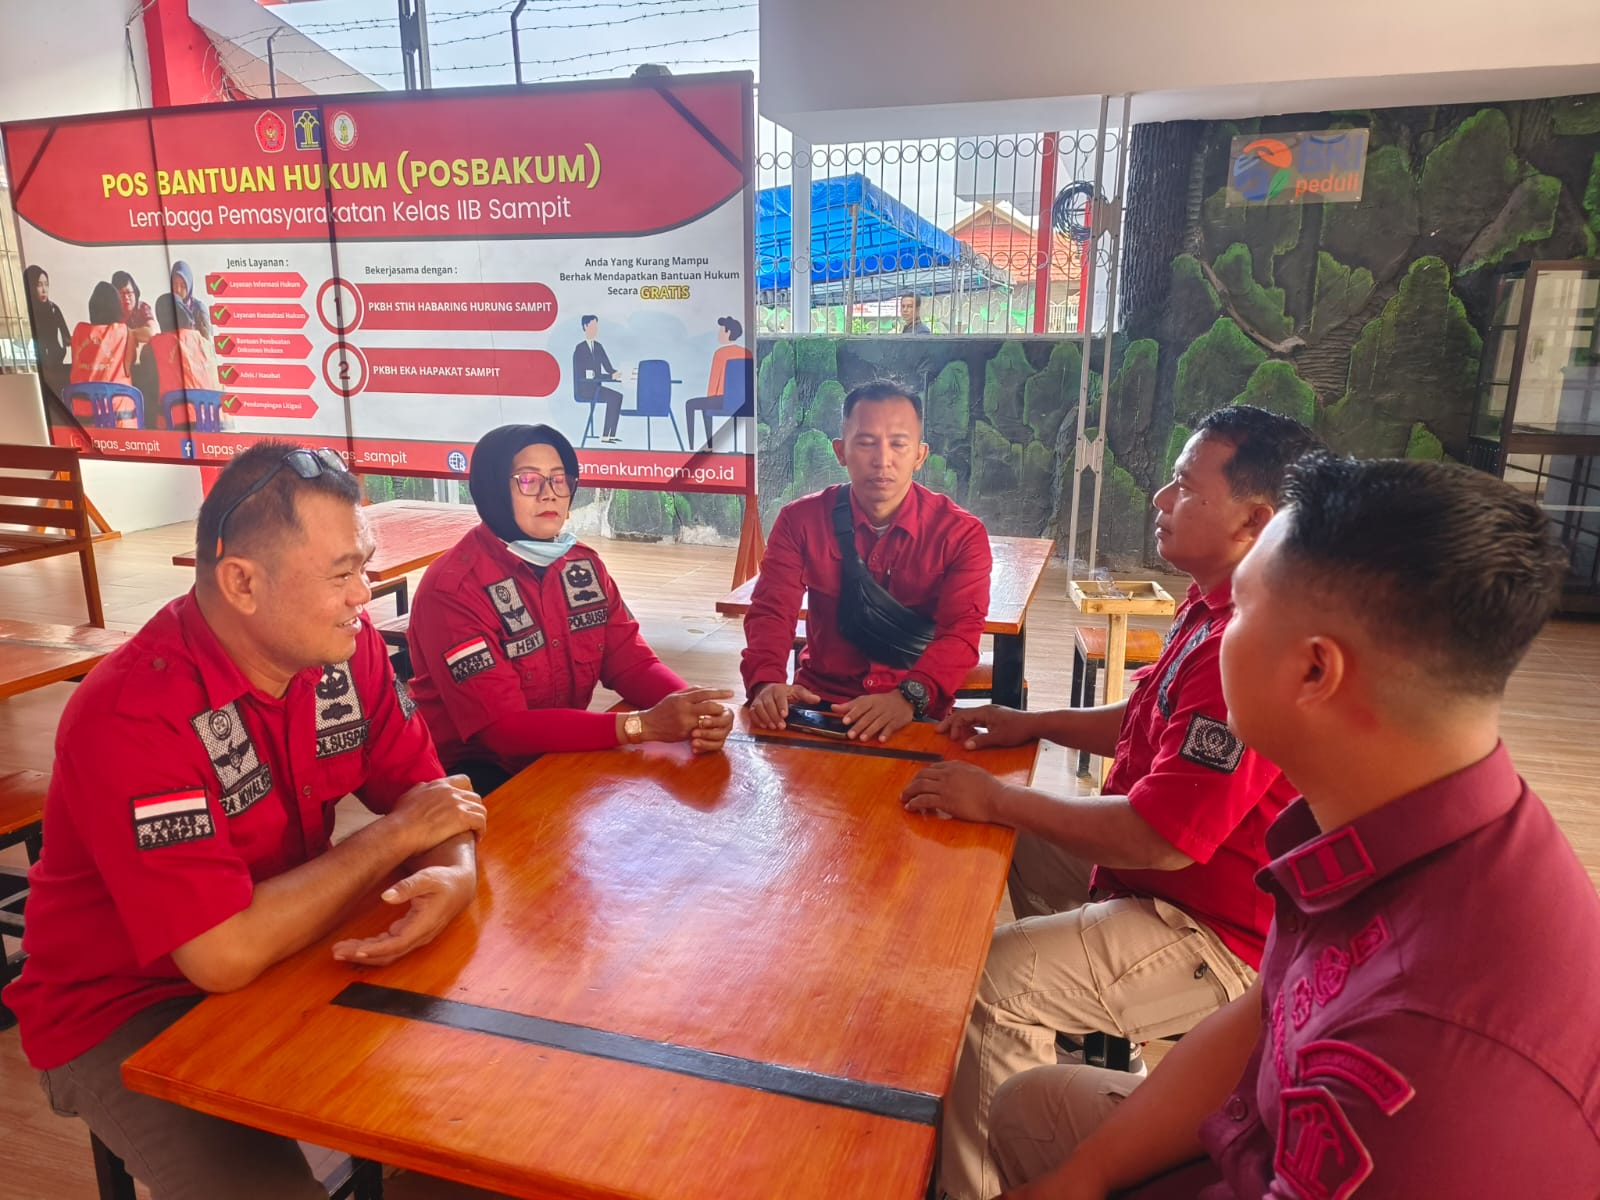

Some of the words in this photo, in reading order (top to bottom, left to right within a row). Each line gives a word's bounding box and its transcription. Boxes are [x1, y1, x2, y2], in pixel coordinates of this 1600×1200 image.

[102, 172, 149, 198] POS
[157, 166, 275, 195] BANTUAN
[284, 162, 387, 192] HUKUM
[397, 143, 600, 194] (POSBAKUM)
[1295, 173, 1359, 199] peduli
[129, 206, 213, 232] Lembaga
[218, 203, 386, 230] Pemasyarakatan
[392, 201, 450, 222] Kelas
[457, 200, 481, 220] IIB
[489, 196, 571, 224] Sampit
[227, 258, 246, 269] Jenis
[249, 258, 284, 269] Layanan
[585, 258, 608, 267] Anda
[611, 258, 633, 268] Yang
[636, 257, 669, 268] Kurang
[672, 256, 708, 267] Mampu
[365, 266, 419, 276] Bekerjasama
[421, 266, 453, 276] dengan
[560, 272, 591, 281] Berhak
[594, 272, 658, 282] Mendapatkan
[661, 271, 701, 280] Bantuan
[704, 270, 739, 280] Hukum
[608, 286, 638, 295] Secara
[640, 285, 690, 299] GRATIS
[368, 302, 393, 311] PKBH
[394, 302, 416, 311] STIH
[418, 302, 467, 311] HABARING
[470, 302, 513, 312] HURUNG
[515, 302, 551, 312] SAMPIT
[338, 361, 350, 380] 2
[373, 366, 398, 375] PKBH
[400, 366, 417, 375] EKA
[420, 366, 463, 376] HAPAKAT
[465, 367, 500, 377] SAMPIT
[202, 443, 234, 456] Lapas
[340, 450, 407, 466] as_sampit
[578, 461, 734, 483] emenkumham.go.id
